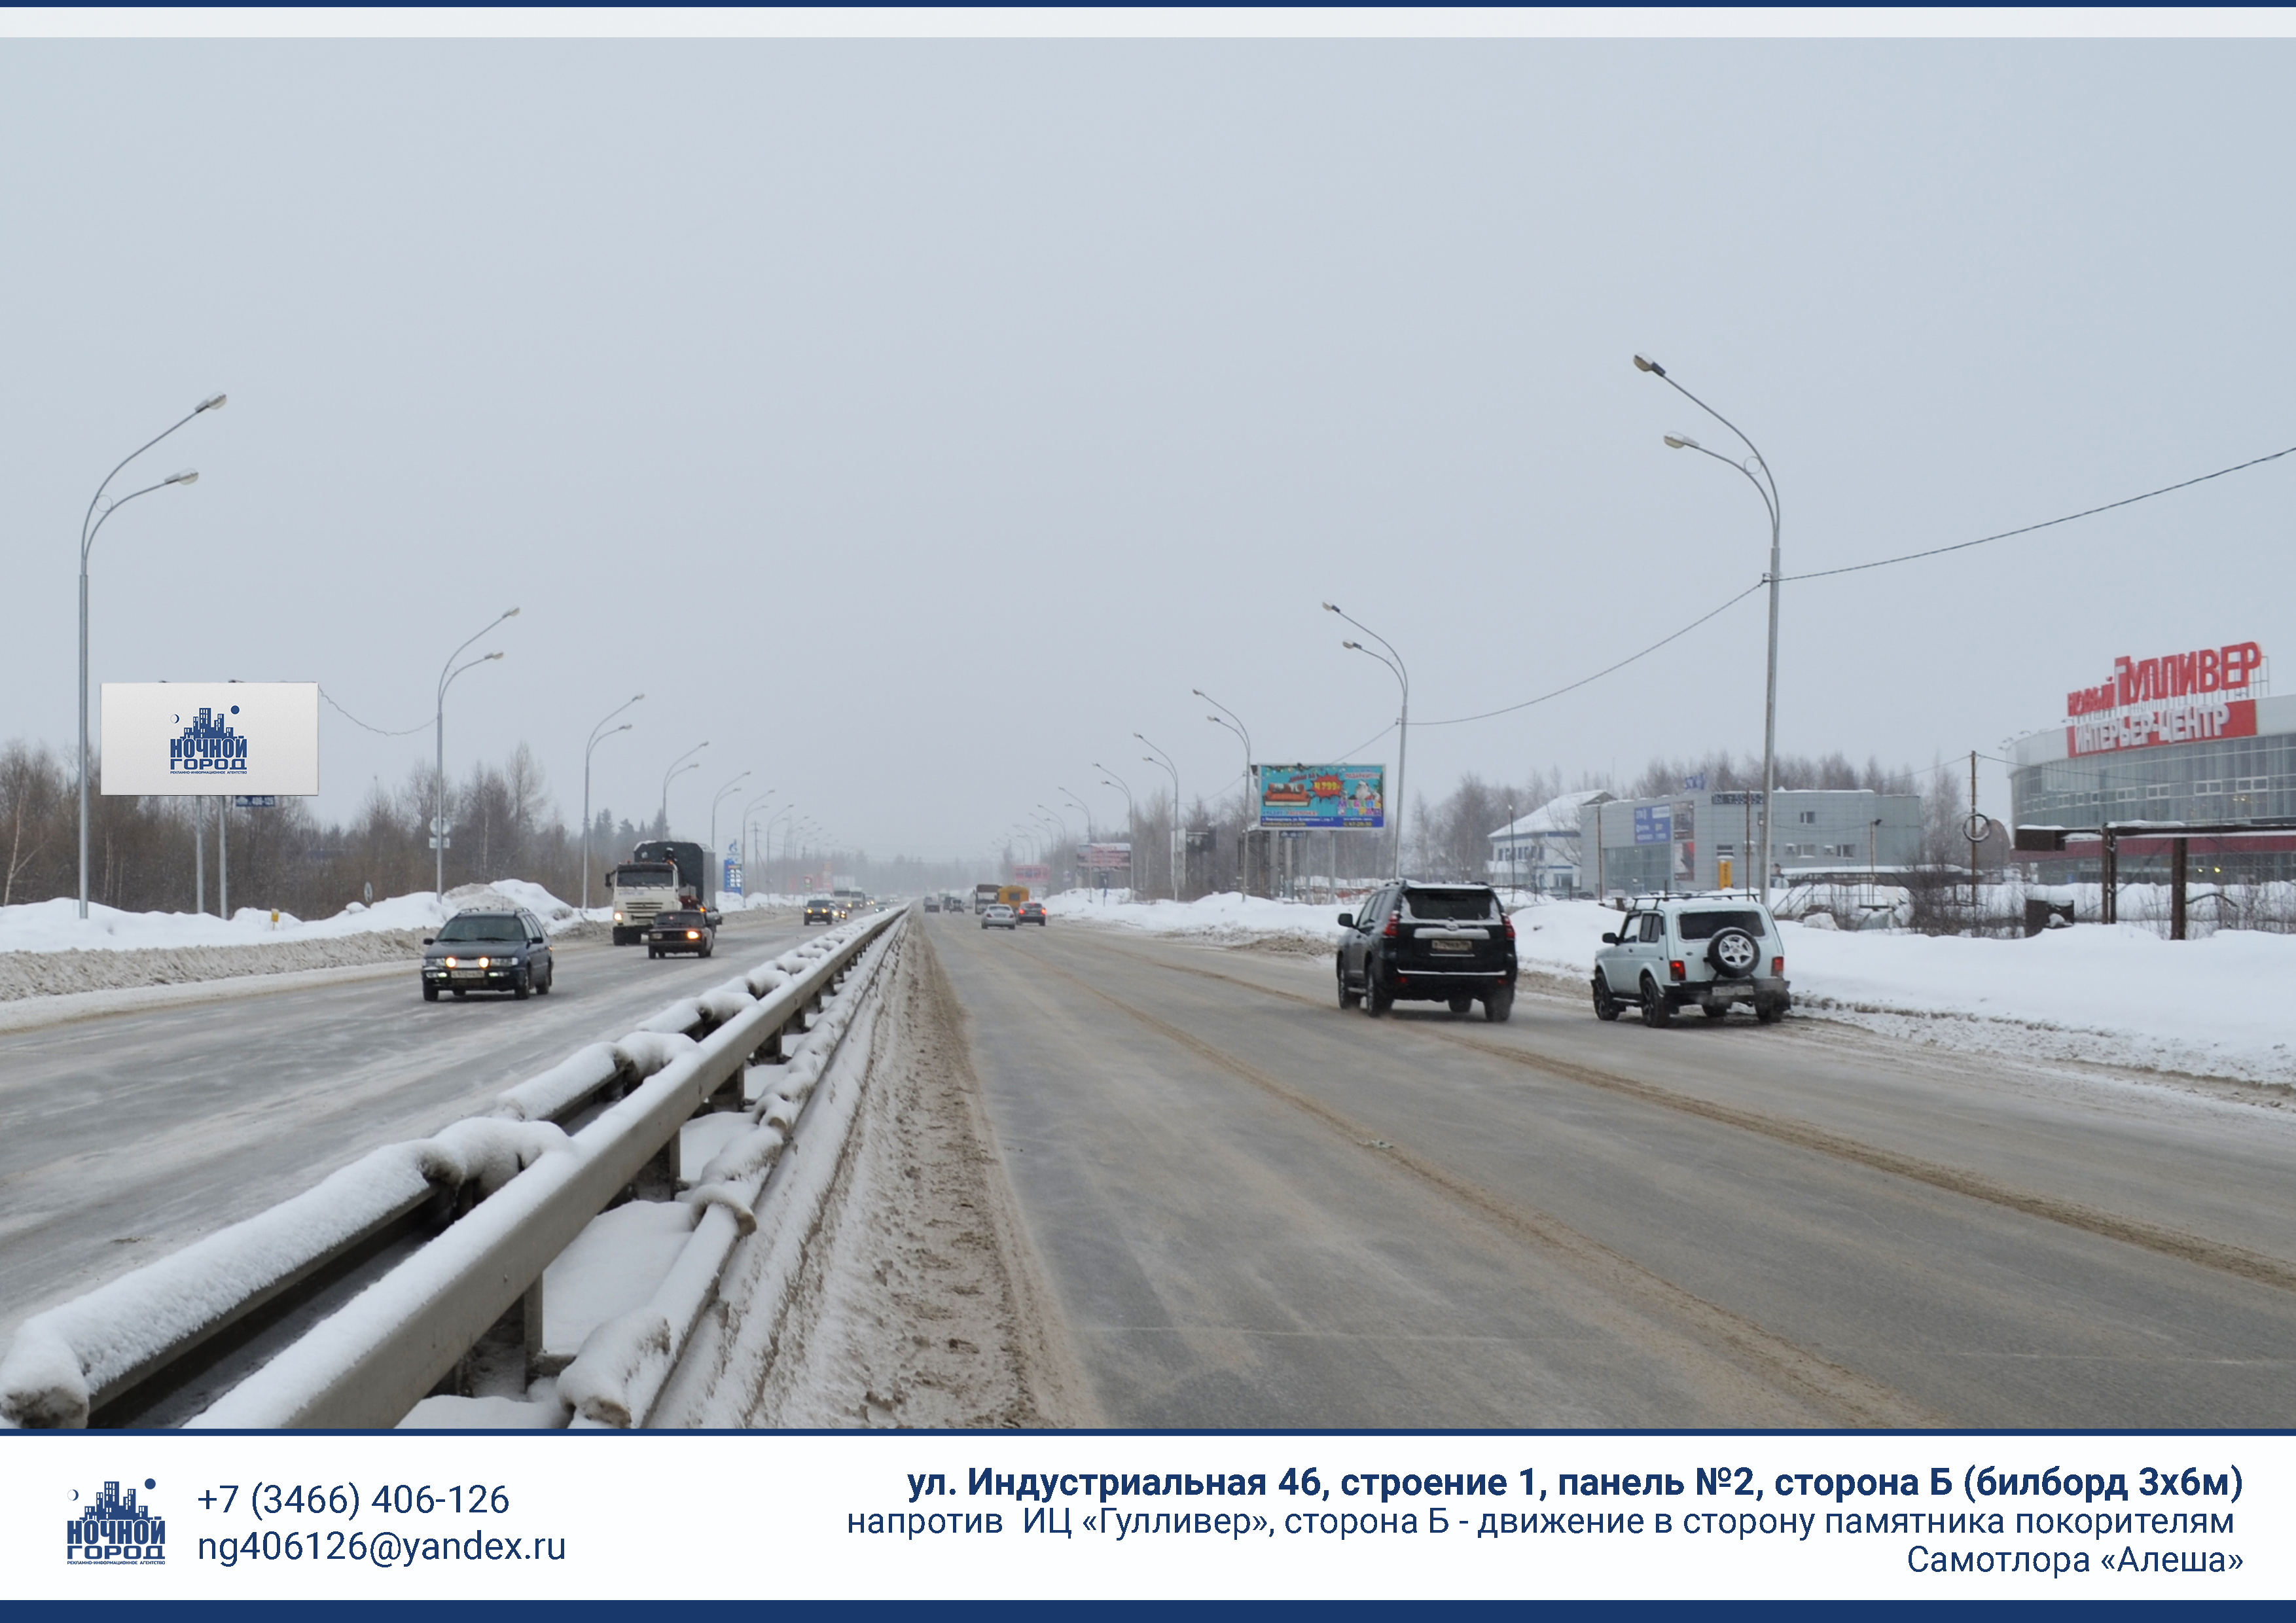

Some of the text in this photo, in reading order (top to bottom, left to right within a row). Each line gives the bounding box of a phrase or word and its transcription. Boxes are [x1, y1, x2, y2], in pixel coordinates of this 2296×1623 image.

[2068, 641, 2262, 717] НОВЫЙ ГУЛЛИВЕР
[170, 736, 247, 758] НОЧНОЙ
[2074, 704, 2230, 754] ИНТЕРЬЕР-ЦЕНТР
[170, 758, 247, 770] ГОРОД
